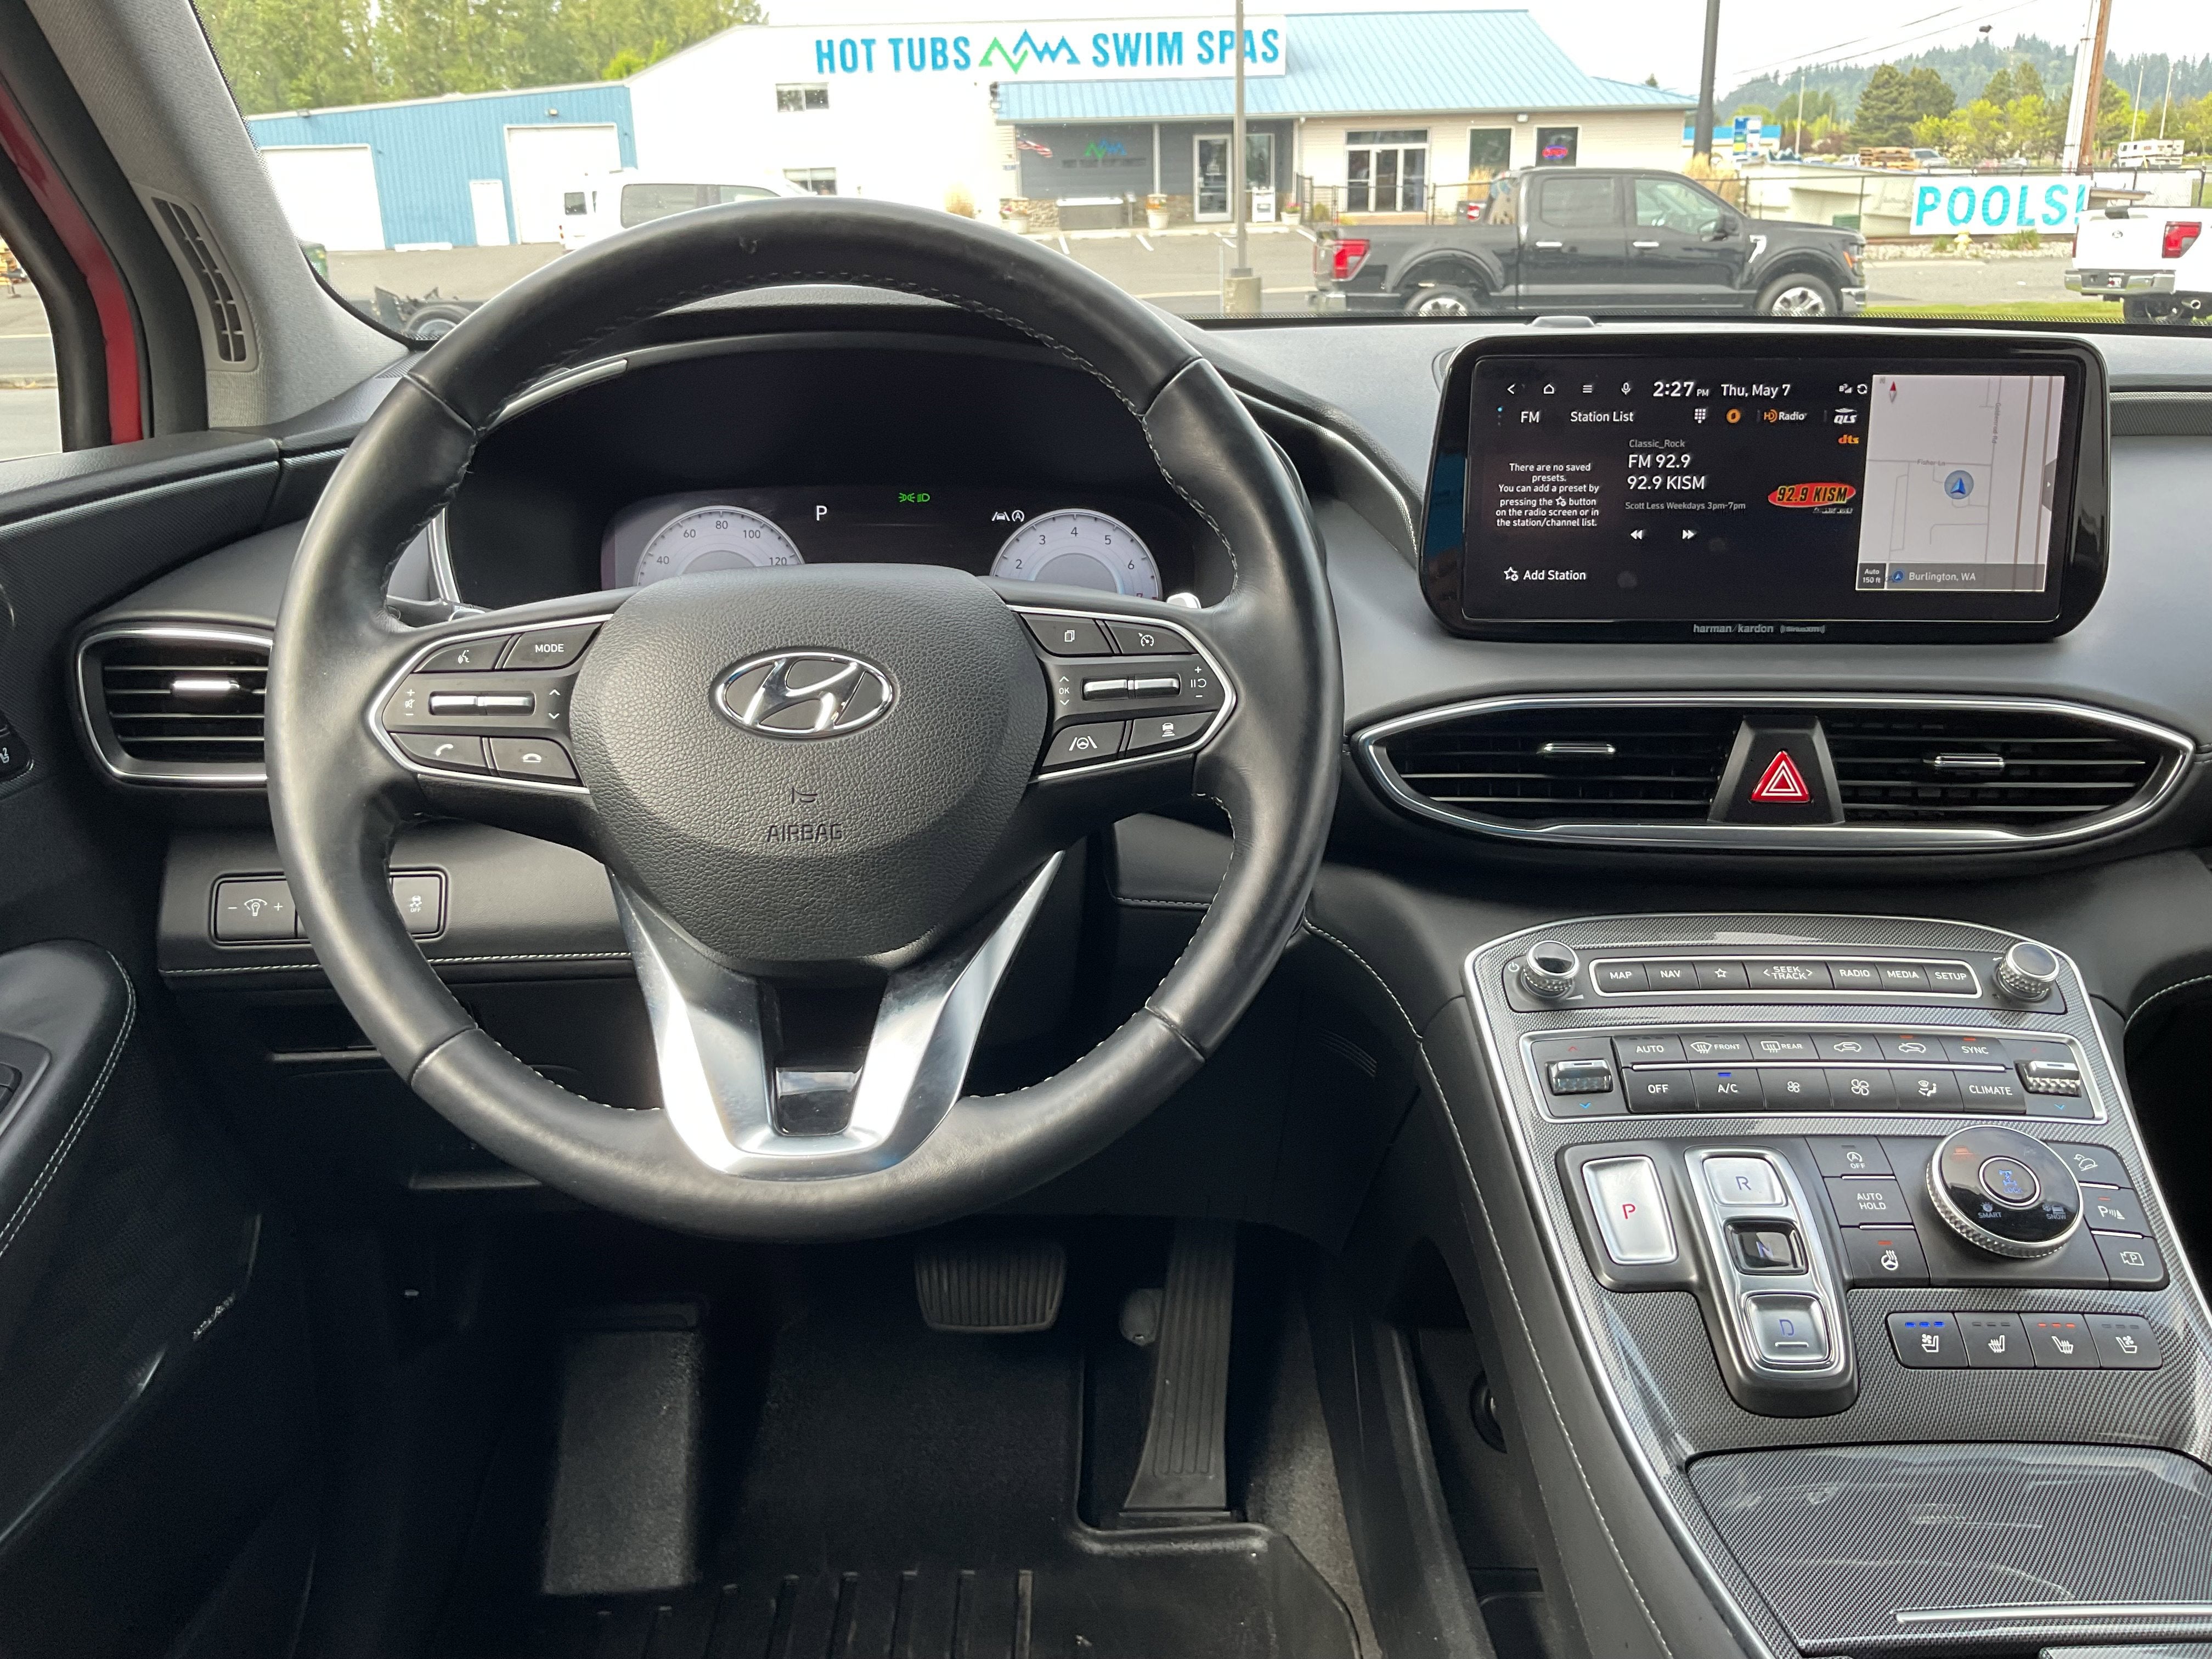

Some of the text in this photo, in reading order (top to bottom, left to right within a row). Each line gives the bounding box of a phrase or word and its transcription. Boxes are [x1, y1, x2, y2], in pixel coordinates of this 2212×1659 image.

[816, 29, 1279, 75] HOT TUBS SWIM SPAS
[1915, 184, 2086, 226] POOLS!
[1653, 381, 1695, 397] 2:27
[1721, 384, 1748, 397] Thu,
[1752, 384, 1778, 399] May
[1782, 384, 1791, 396] 7
[1521, 411, 1539, 423] FM
[1570, 411, 1634, 422] Station List
[1779, 412, 1805, 421] Radio
[1629, 439, 1685, 449] Classic_Rock
[1838, 435, 1859, 444] dts
[1628, 454, 1691, 468] FM 92.9
[1509, 463, 1534, 471] There
[1566, 463, 1591, 471] saved
[1532, 475, 1567, 483] presets.
[1627, 476, 1705, 490] 92.9 KISM
[1559, 485, 1587, 494] preset
[1589, 484, 1600, 494] by
[1777, 487, 1848, 501] 92.9 KISM
[1500, 498, 1596, 507] pressing the button
[1667, 502, 1706, 511] Weekdays
[1707, 502, 1746, 511] 3pm-7pm
[816, 505, 828, 521] P
[1509, 508, 1522, 516] the
[1524, 508, 1547, 516] radio
[1591, 508, 1599, 516] in
[715, 521, 729, 529] 80
[1497, 518, 1598, 527] the station/channel list.
[683, 529, 697, 539] 60
[743, 529, 761, 539] 100
[1070, 527, 1079, 537] 4
[1039, 535, 1046, 545] 3
[1104, 535, 1111, 545] 5
[657, 556, 670, 565] 40
[769, 557, 787, 566] 120
[1015, 560, 1023, 569] 2
[1127, 560, 1135, 570] 6
[1523, 570, 1587, 580] Add Station
[1909, 572, 1976, 583] Burlington, WA
[535, 644, 565, 653] MODE
[2, 747, 9, 757] 2
[767, 823, 843, 843] AIRBAG
[1660, 969, 1681, 978] NAV
[1773, 965, 1801, 973] SEEK
[1839, 969, 1870, 978] RADIO
[1609, 970, 1633, 980] MAP
[1771, 972, 1808, 980] TRACK
[1887, 970, 1920, 979] MEDIA
[1934, 972, 1967, 981] SETUP
[1635, 1045, 1664, 1054] AUTO
[1961, 1046, 1989, 1056] SYNC
[1647, 1084, 1669, 1094] OFF
[1717, 1083, 1739, 1094] A/C
[1968, 1085, 2013, 1096] CLIMATE
[1735, 1176, 1751, 1191] R
[1857, 1192, 1883, 1201] AUTO
[1859, 1202, 1886, 1210] HOLD
[1622, 1203, 1636, 1220] P
[2097, 1205, 2108, 1218] P
[1757, 1241, 1772, 1257] N
[2129, 1253, 2138, 1263] P
[1779, 1318, 1795, 1337] D
